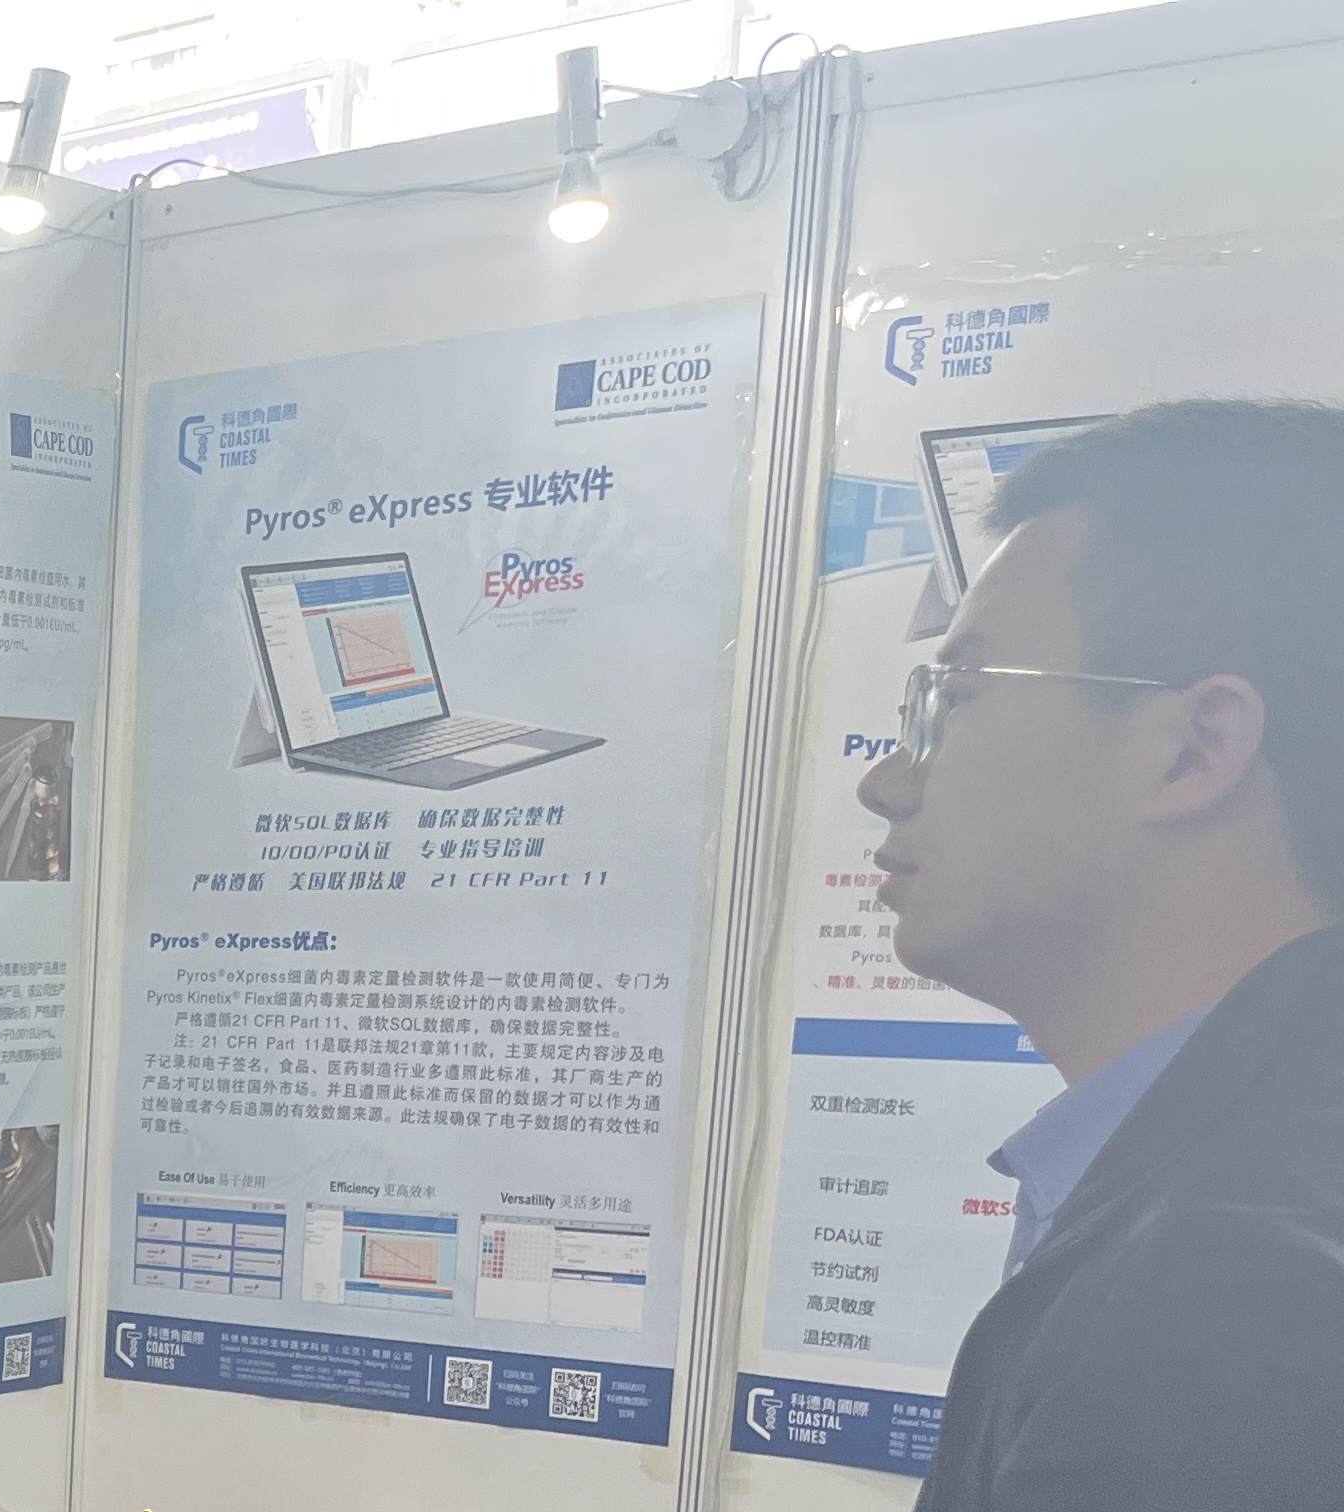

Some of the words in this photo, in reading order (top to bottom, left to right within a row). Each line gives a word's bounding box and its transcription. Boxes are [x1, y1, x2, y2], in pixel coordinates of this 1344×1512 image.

[944, 302, 1050, 331] 科德角國際
[942, 330, 1014, 355] COASTAL
[597, 365, 656, 393] CAPE
[662, 358, 712, 384] COD
[941, 355, 992, 379] TIMES
[34, 429, 65, 452] CAPE
[68, 434, 93, 456] COD
[220, 428, 271, 449] COASTAL
[220, 449, 257, 469] TIMES
[349, 490, 472, 528] eXpress
[483, 465, 614, 512] 专业软件
[501, 553, 574, 584] Pyros
[418, 805, 565, 829] 确保数据完整性
[420, 838, 545, 859] 专业指导培训
[288, 871, 406, 891] 美国联邦法规
[430, 872, 456, 888] 21
[469, 872, 511, 888] CFR
[519, 872, 569, 887] Part
[146, 990, 183, 1006] Pyros
[254, 1014, 285, 1028] CFR
[289, 1015, 319, 1029] Part
[227, 1035, 257, 1049] CFR
[267, 1036, 295, 1051] Part
[809, 1095, 915, 1116] 双重检测波长
[158, 1171, 181, 1183] Ease
[184, 1172, 196, 1184] Of
[197, 1174, 215, 1185] Use
[819, 1176, 889, 1196] 审计追踪
[330, 1181, 380, 1197] Efficiency
[500, 1192, 556, 1209] Versatility
[814, 1227, 883, 1248] FDA认证
[810, 1261, 879, 1283] 节约试剂
[806, 1294, 876, 1317] 高灵敏度
[146, 1341, 186, 1357] COASTAL
[803, 1328, 872, 1351] 温控精准
[146, 1354, 175, 1370] TIMES
[790, 1393, 870, 1417] 科德角國際
[788, 1410, 842, 1430] COASTAL
[788, 1427, 827, 1445] TIMES
